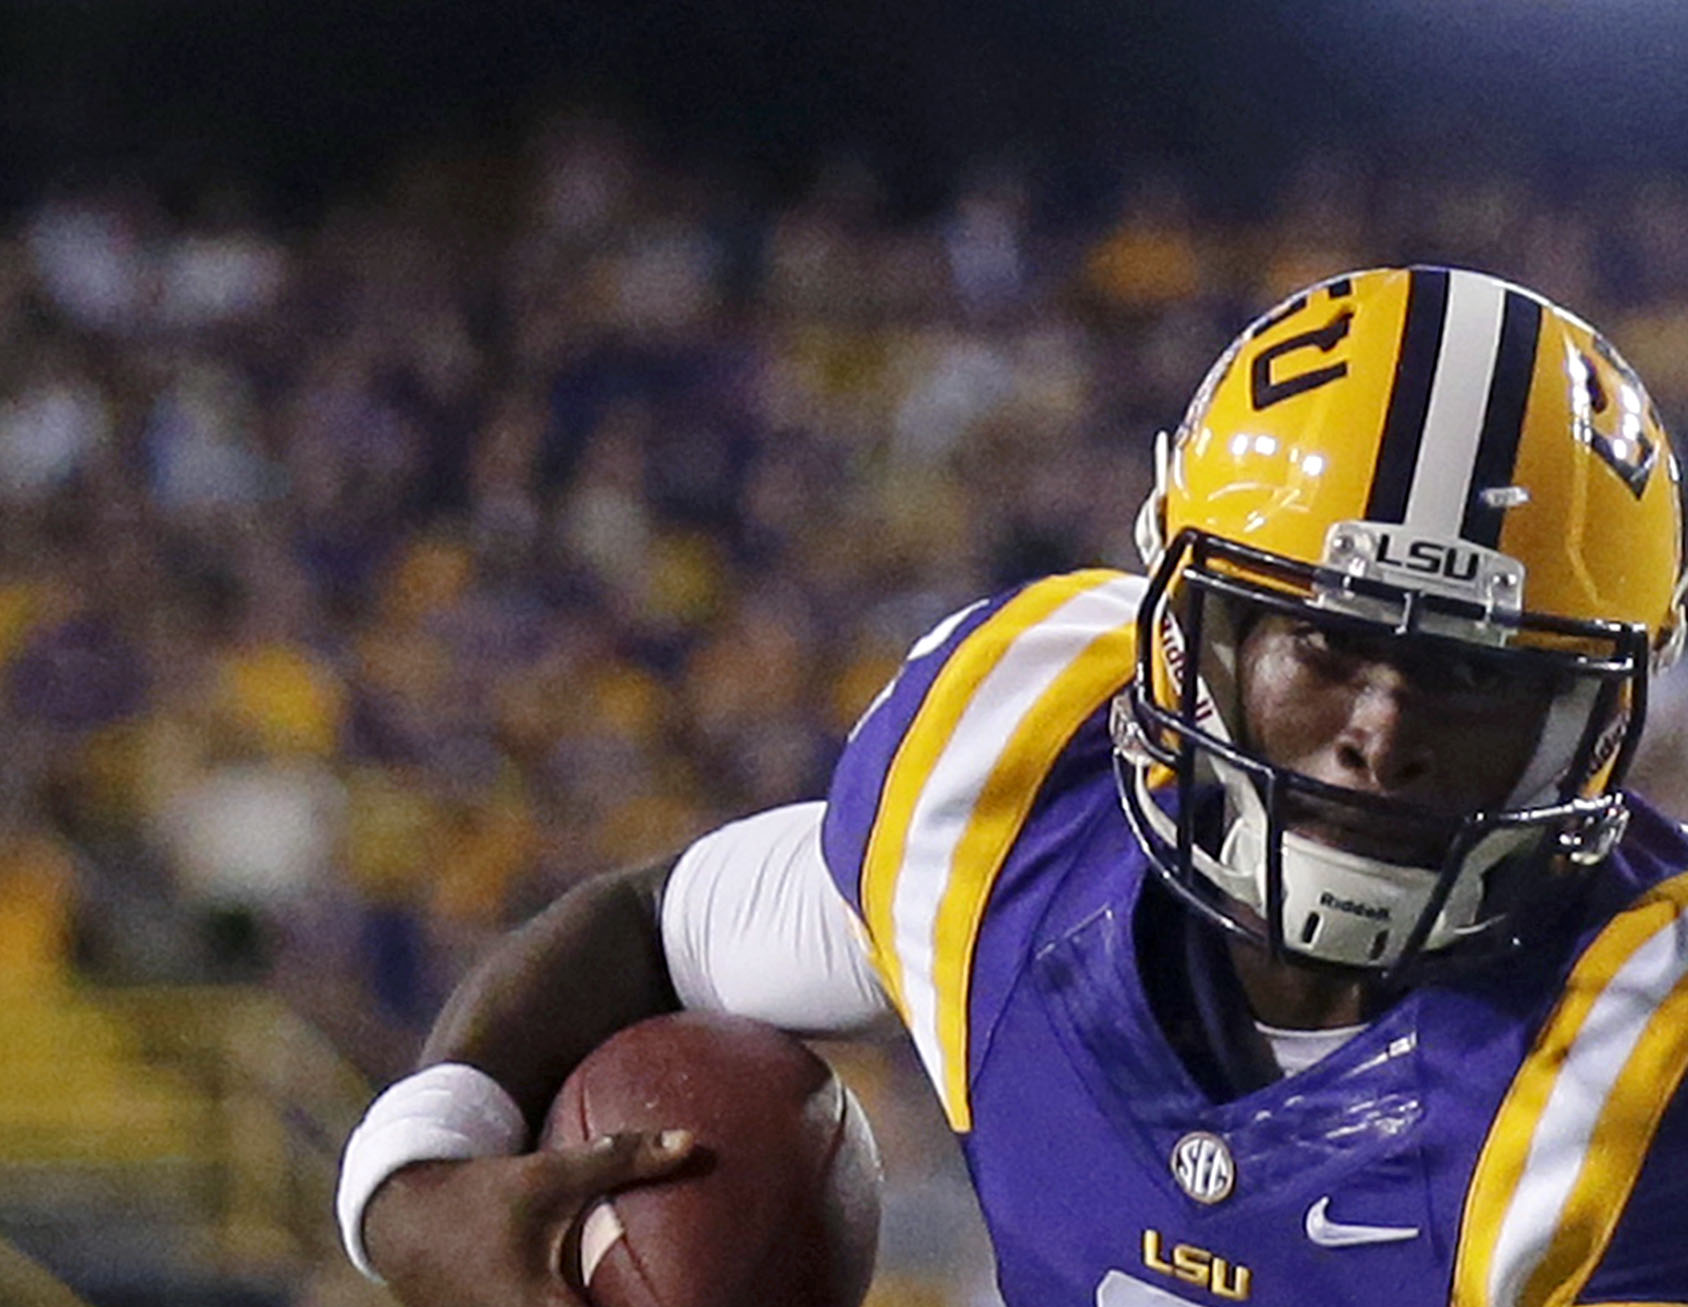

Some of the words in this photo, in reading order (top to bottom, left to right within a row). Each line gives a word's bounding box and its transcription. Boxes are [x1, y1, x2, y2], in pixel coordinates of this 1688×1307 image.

[1375, 533, 1480, 582] LSU
[1177, 1137, 1229, 1198] SEC
[1143, 1229, 1252, 1301] LSU
